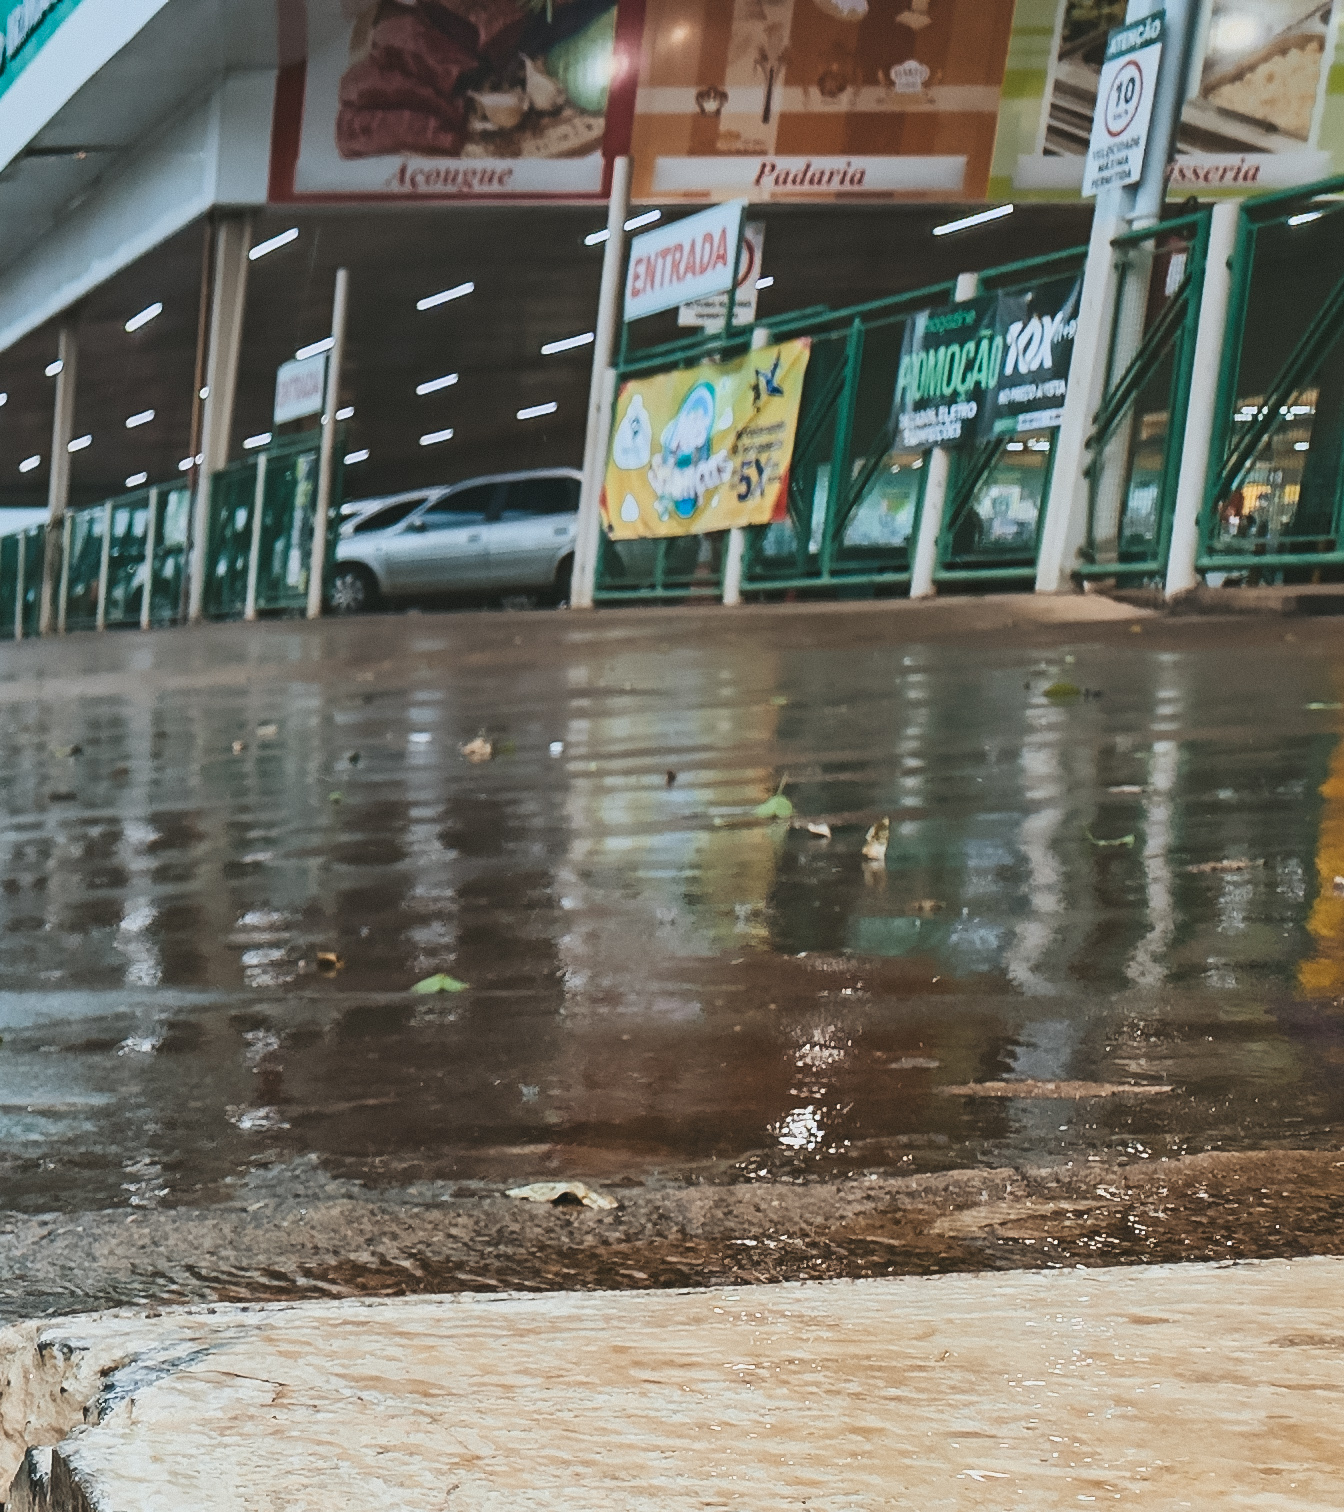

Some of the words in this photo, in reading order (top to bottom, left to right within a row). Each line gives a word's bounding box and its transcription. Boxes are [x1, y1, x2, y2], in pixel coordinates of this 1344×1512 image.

[1115, 77, 1136, 107] 10
[387, 161, 512, 191] Açougue
[754, 161, 865, 186] Padaria
[631, 226, 727, 299] ENTRADA
